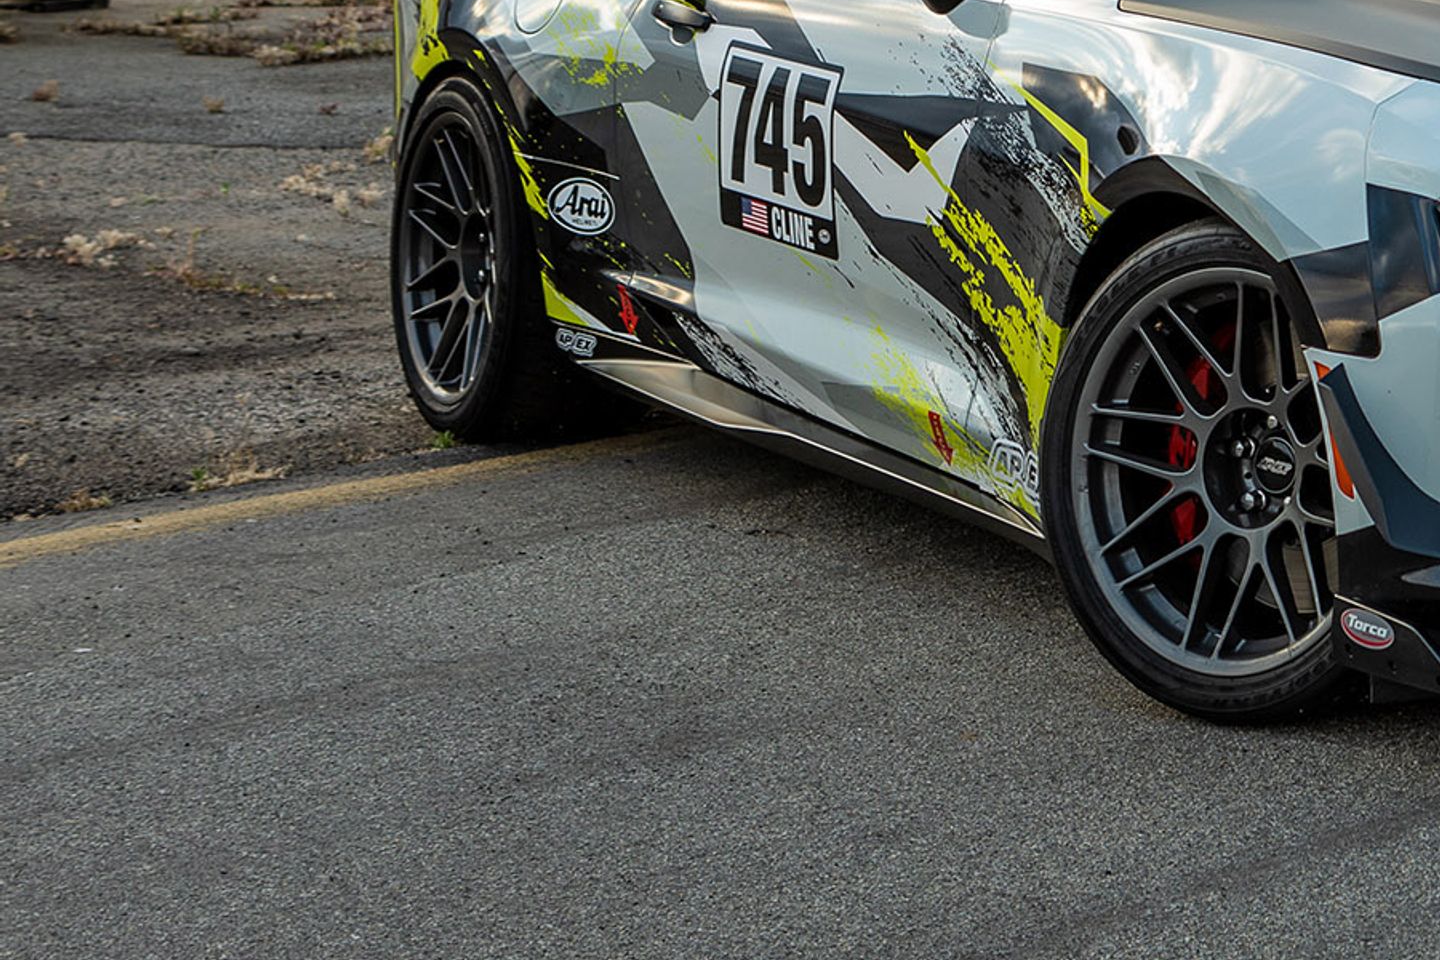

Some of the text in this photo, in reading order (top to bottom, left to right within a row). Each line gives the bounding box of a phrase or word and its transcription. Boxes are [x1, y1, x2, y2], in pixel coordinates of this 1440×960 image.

[727, 55, 832, 208] 745
[554, 184, 607, 219] Arai
[771, 205, 816, 251] CLINE
[1348, 613, 1388, 639] Torco
